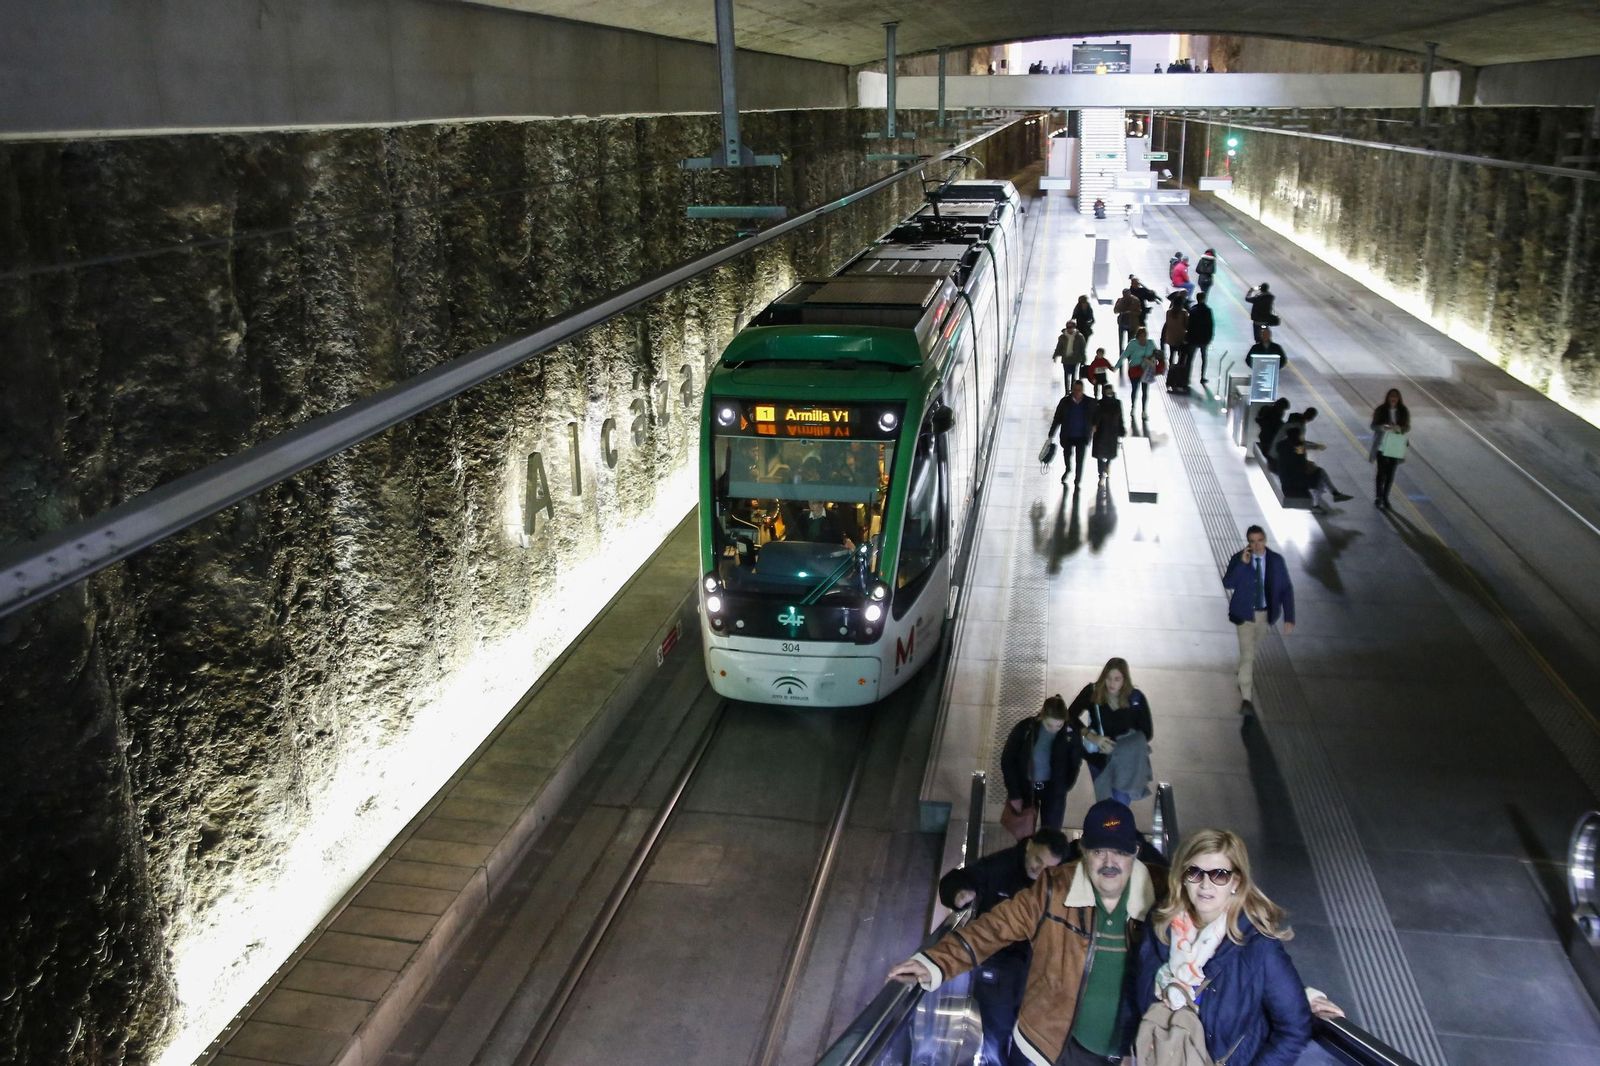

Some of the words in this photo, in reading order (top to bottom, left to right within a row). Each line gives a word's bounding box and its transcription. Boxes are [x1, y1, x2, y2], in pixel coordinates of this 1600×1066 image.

[763, 410, 769, 419] 1
[786, 409, 830, 422] Armilla
[833, 410, 849, 423] V1
[781, 642, 801, 652] 304
[895, 625, 915, 673] M
